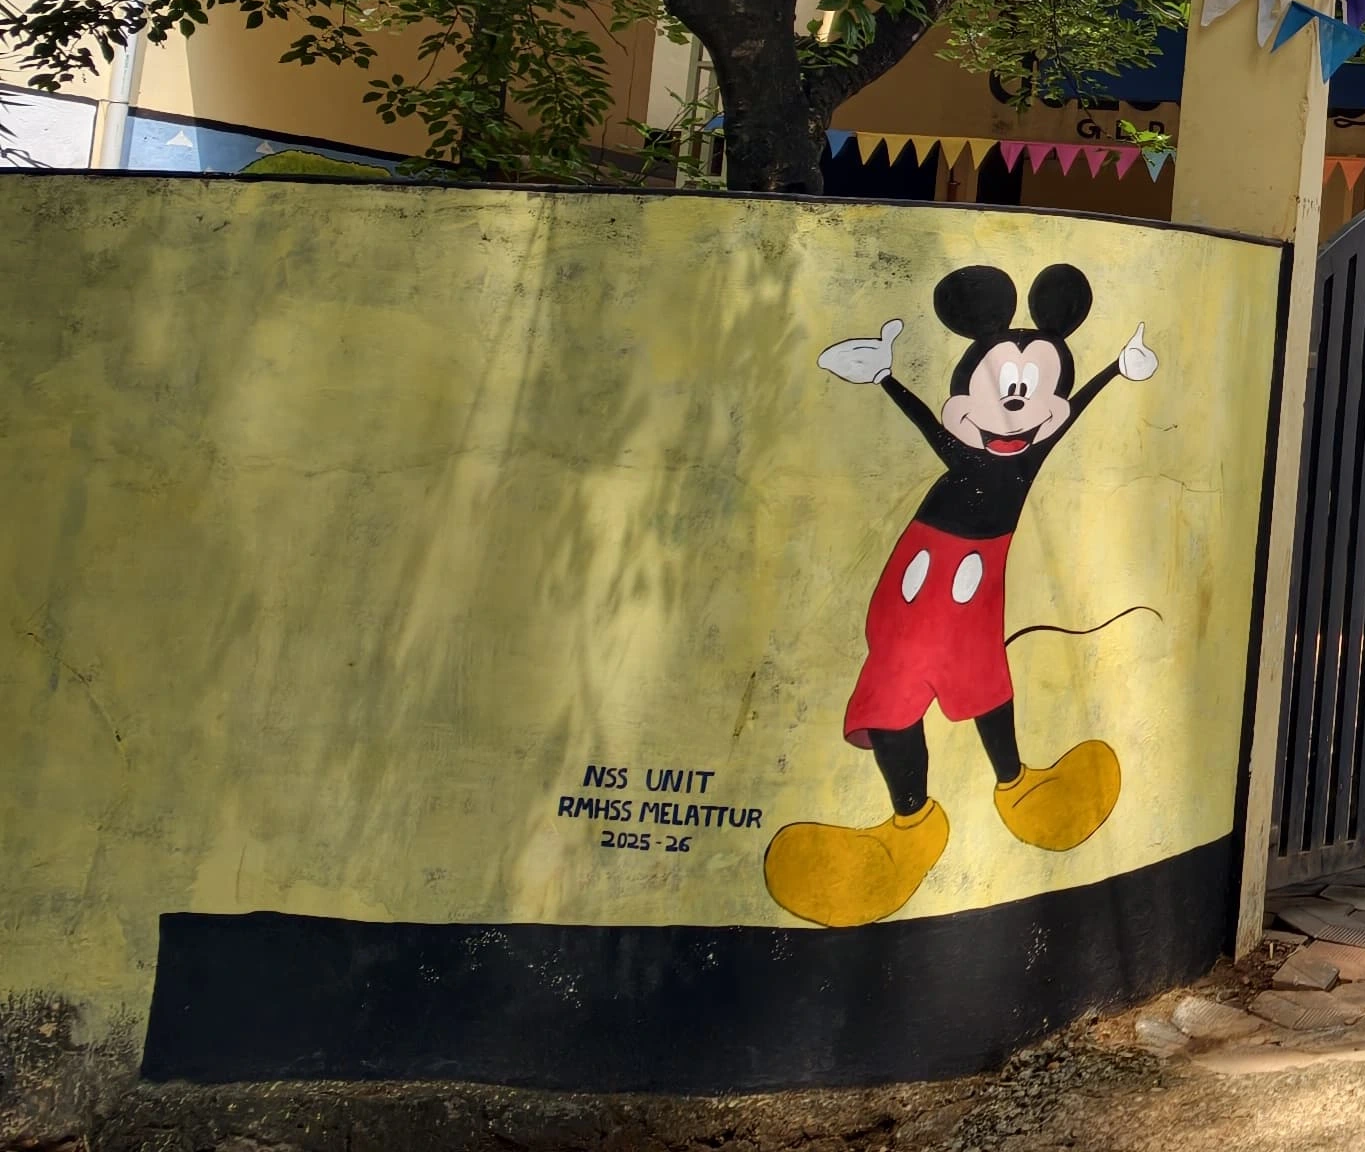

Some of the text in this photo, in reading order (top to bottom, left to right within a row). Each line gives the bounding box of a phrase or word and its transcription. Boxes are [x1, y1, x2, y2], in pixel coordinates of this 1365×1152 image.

[583, 765, 715, 794] NSS UNIT
[558, 796, 763, 829] RMHSS MELATTUR
